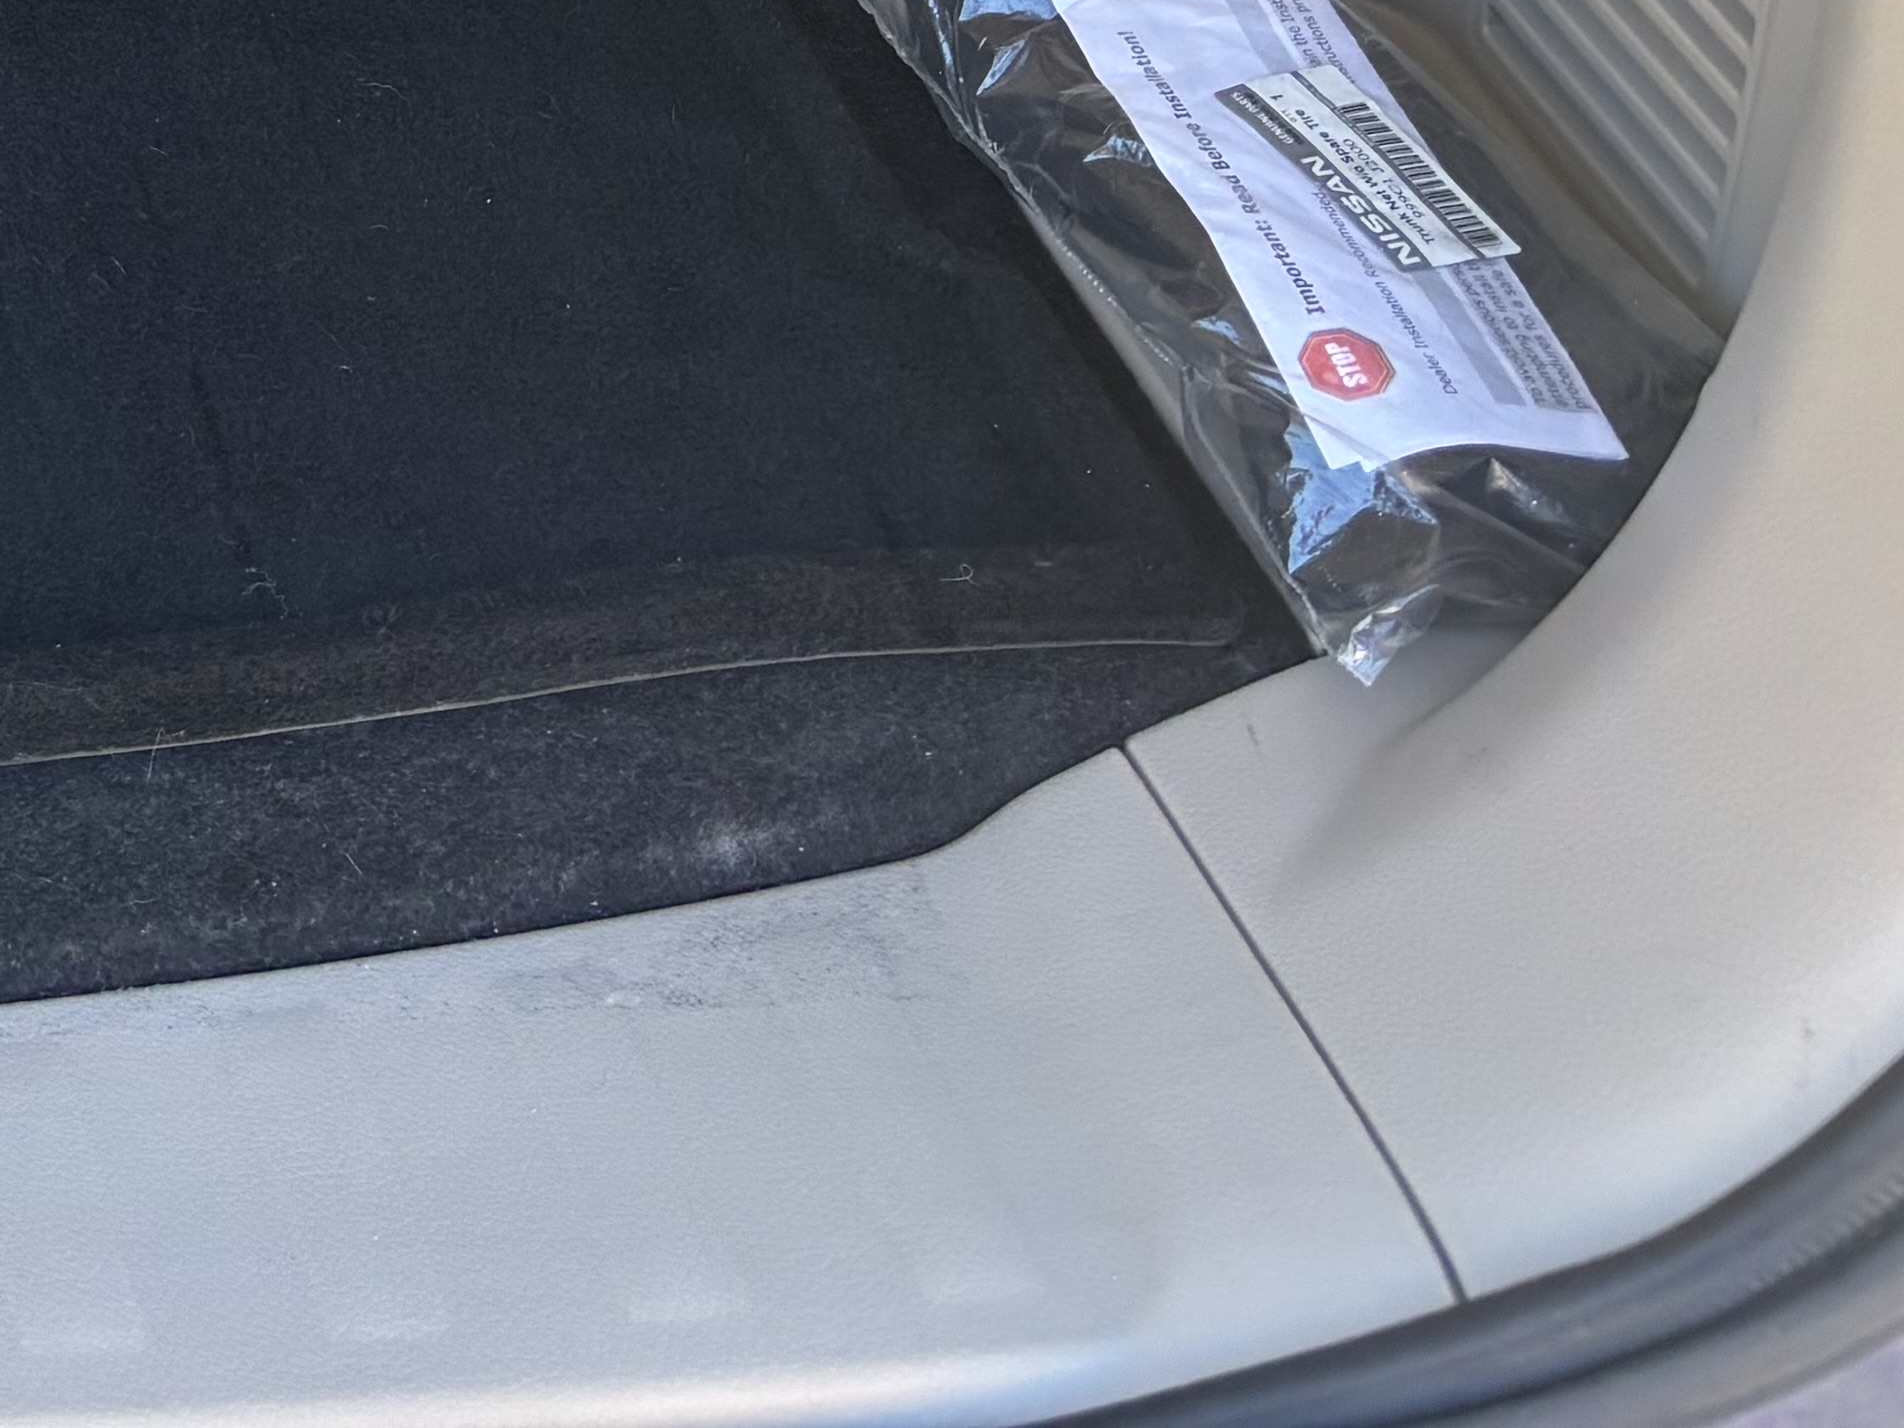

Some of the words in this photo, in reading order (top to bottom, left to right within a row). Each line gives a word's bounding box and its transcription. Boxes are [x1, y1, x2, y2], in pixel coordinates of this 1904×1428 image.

[1285, 25, 1308, 46] the
[1117, 30, 1191, 120] Installation!
[1294, 108, 1319, 131] Tire
[1186, 123, 1231, 171] Before
[1319, 130, 1354, 165] Spare
[1225, 174, 1260, 215] Read
[1301, 155, 1421, 266] NISSAN
[1375, 188, 1405, 213] Net
[1315, 187, 1379, 279] Recommended.
[1398, 211, 1435, 245] Trunk
[1255, 219, 1325, 316] Important:
[1375, 280, 1428, 349] Installation
[1472, 273, 1508, 315] install
[1324, 343, 1368, 388] STOP
[1423, 351, 1458, 396] Dealer
